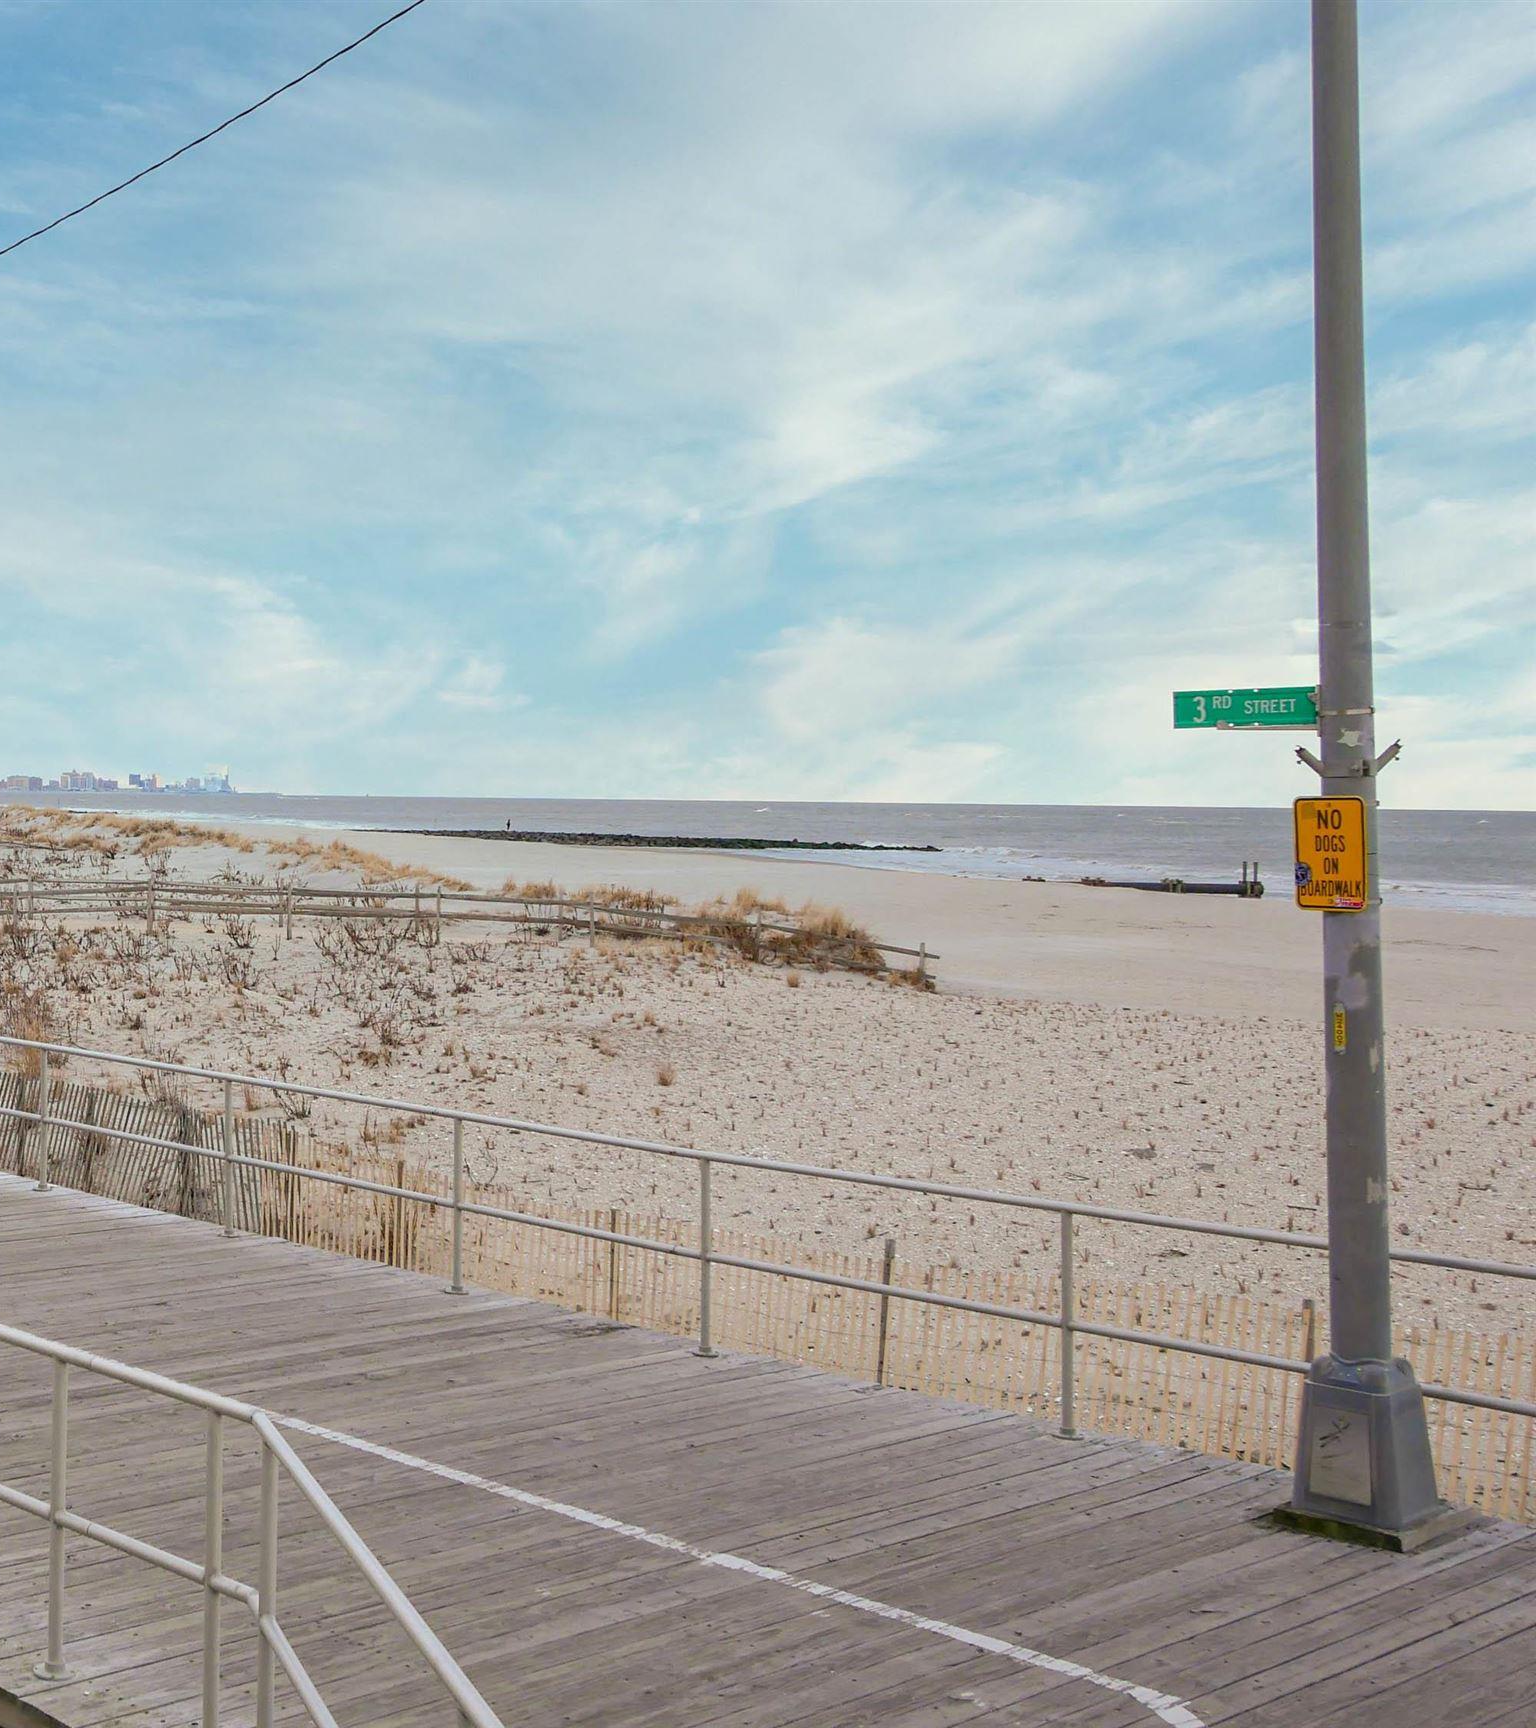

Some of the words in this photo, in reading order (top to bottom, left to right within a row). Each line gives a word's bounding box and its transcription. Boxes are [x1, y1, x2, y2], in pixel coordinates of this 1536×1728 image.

[1244, 698, 1296, 714] STREET
[1317, 809, 1342, 830] NO
[1315, 835, 1345, 852] DOGS
[1323, 857, 1339, 874] ON
